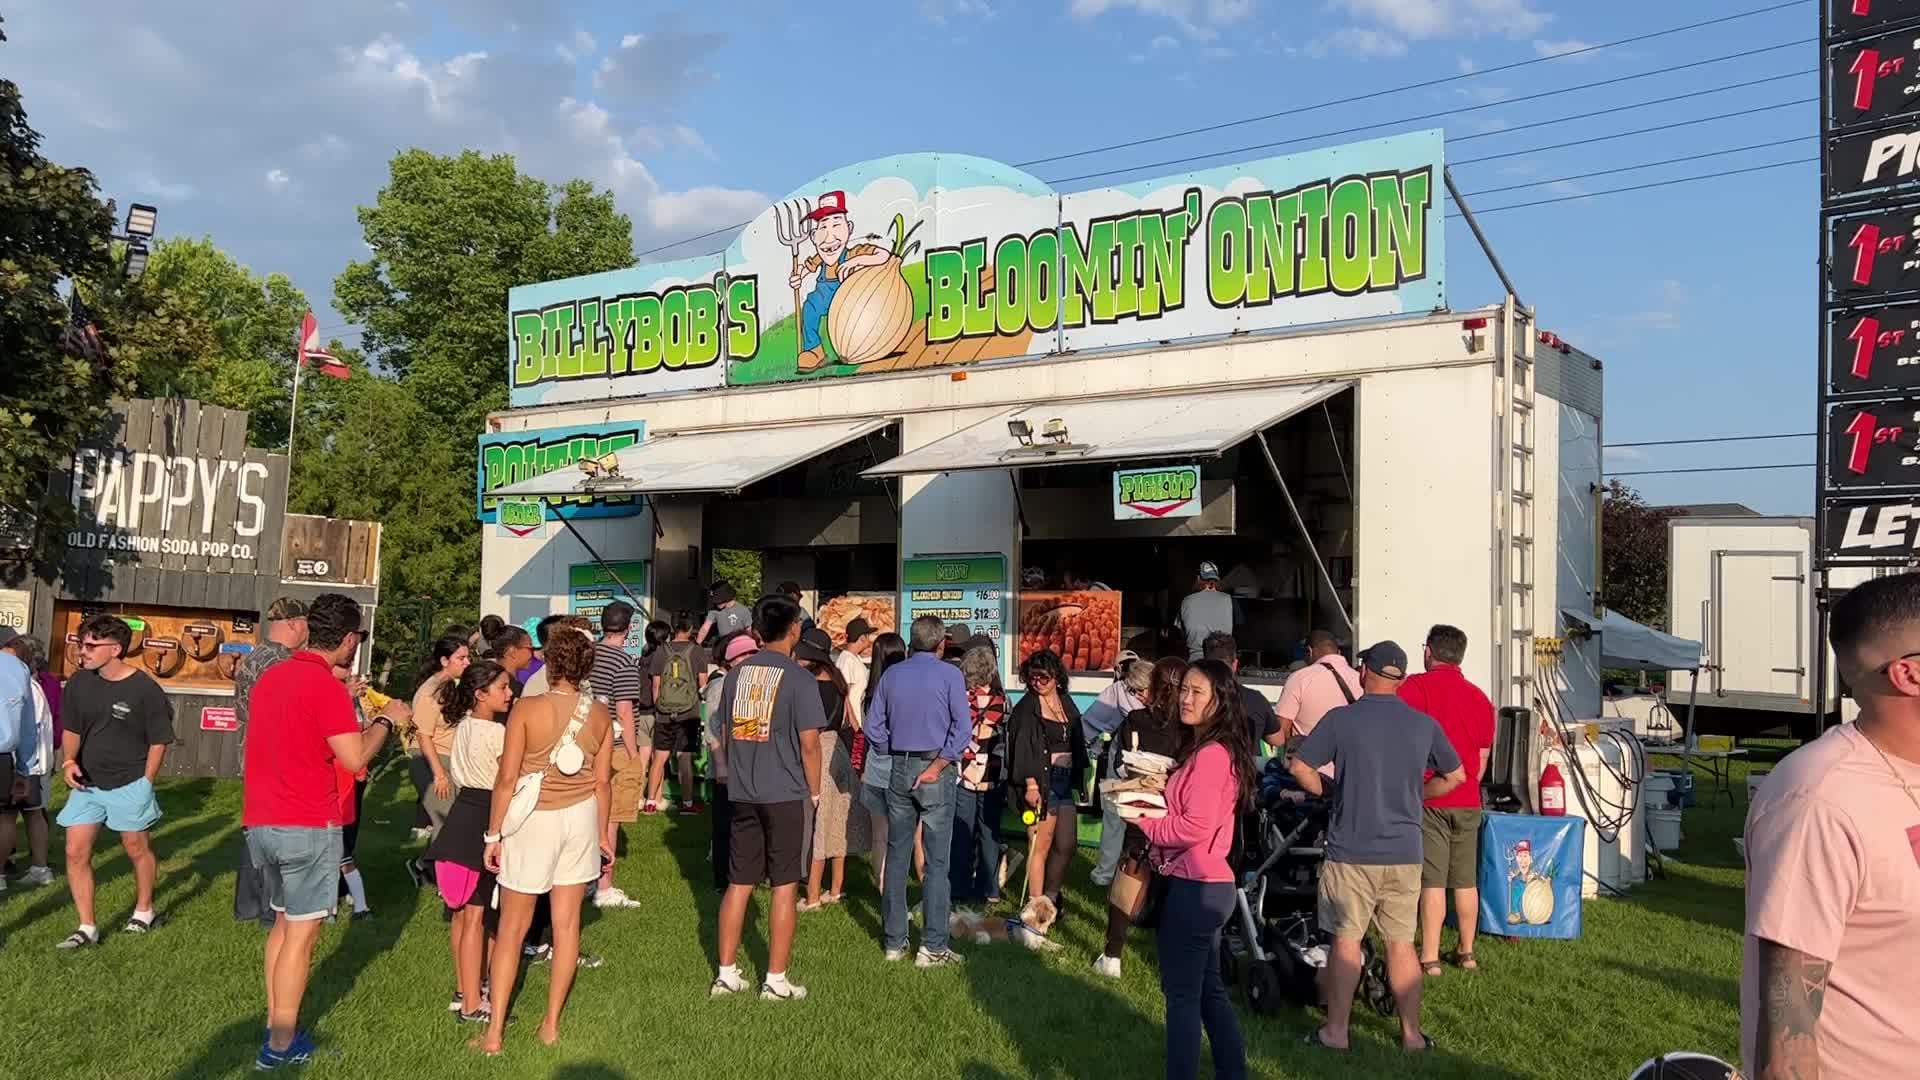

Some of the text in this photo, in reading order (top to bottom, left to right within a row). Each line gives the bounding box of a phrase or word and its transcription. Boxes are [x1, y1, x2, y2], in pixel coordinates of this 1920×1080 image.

[1862, 130, 1920, 183] PI
[513, 164, 1433, 387] BILLYBOB'S BLOOMIN' ONION
[71, 448, 269, 537] PAPPY'S
[1120, 469, 1197, 504] PICKUP
[68, 531, 255, 560] OLD FASHION SODA POP CO.
